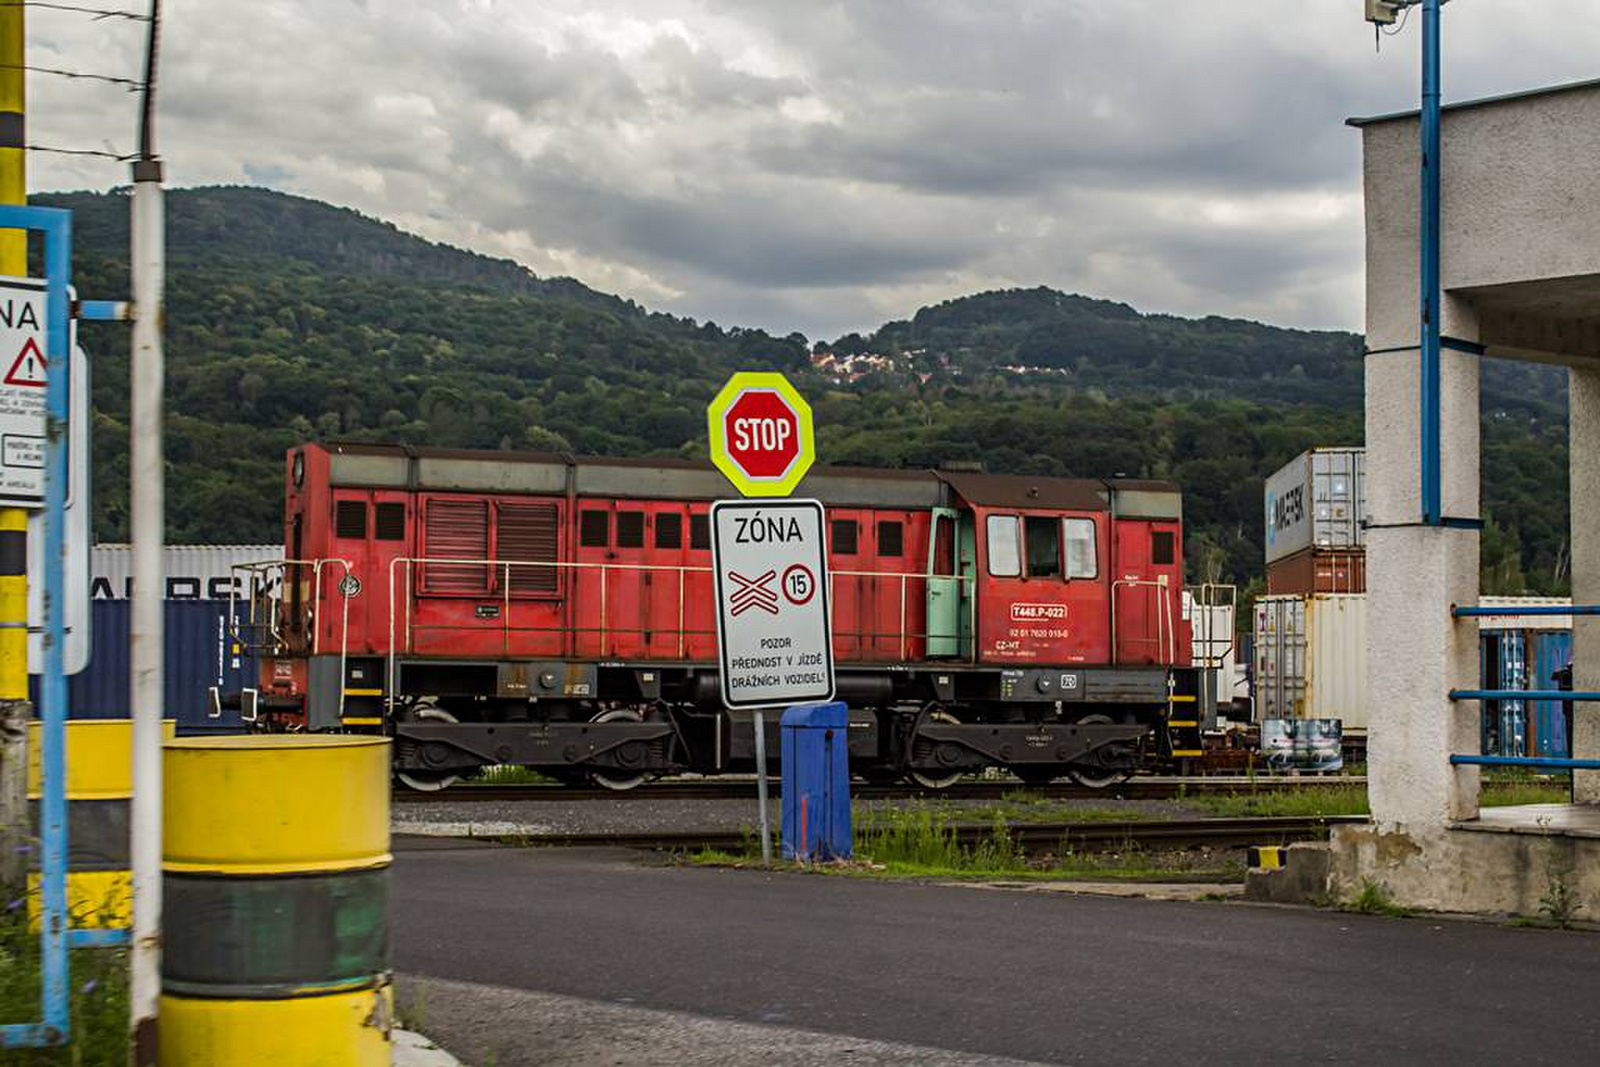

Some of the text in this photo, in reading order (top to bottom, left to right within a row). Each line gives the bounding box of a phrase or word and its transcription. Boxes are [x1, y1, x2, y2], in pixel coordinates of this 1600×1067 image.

[734, 417, 790, 451] STOP
[734, 511, 803, 544] ZÓNA
[790, 574, 807, 595] 15
[761, 637, 792, 649] POZOR
[732, 656, 782, 669] PŘEDNOST
[786, 655, 793, 666] V
[732, 674, 780, 688] DRÁŽNÍCH
